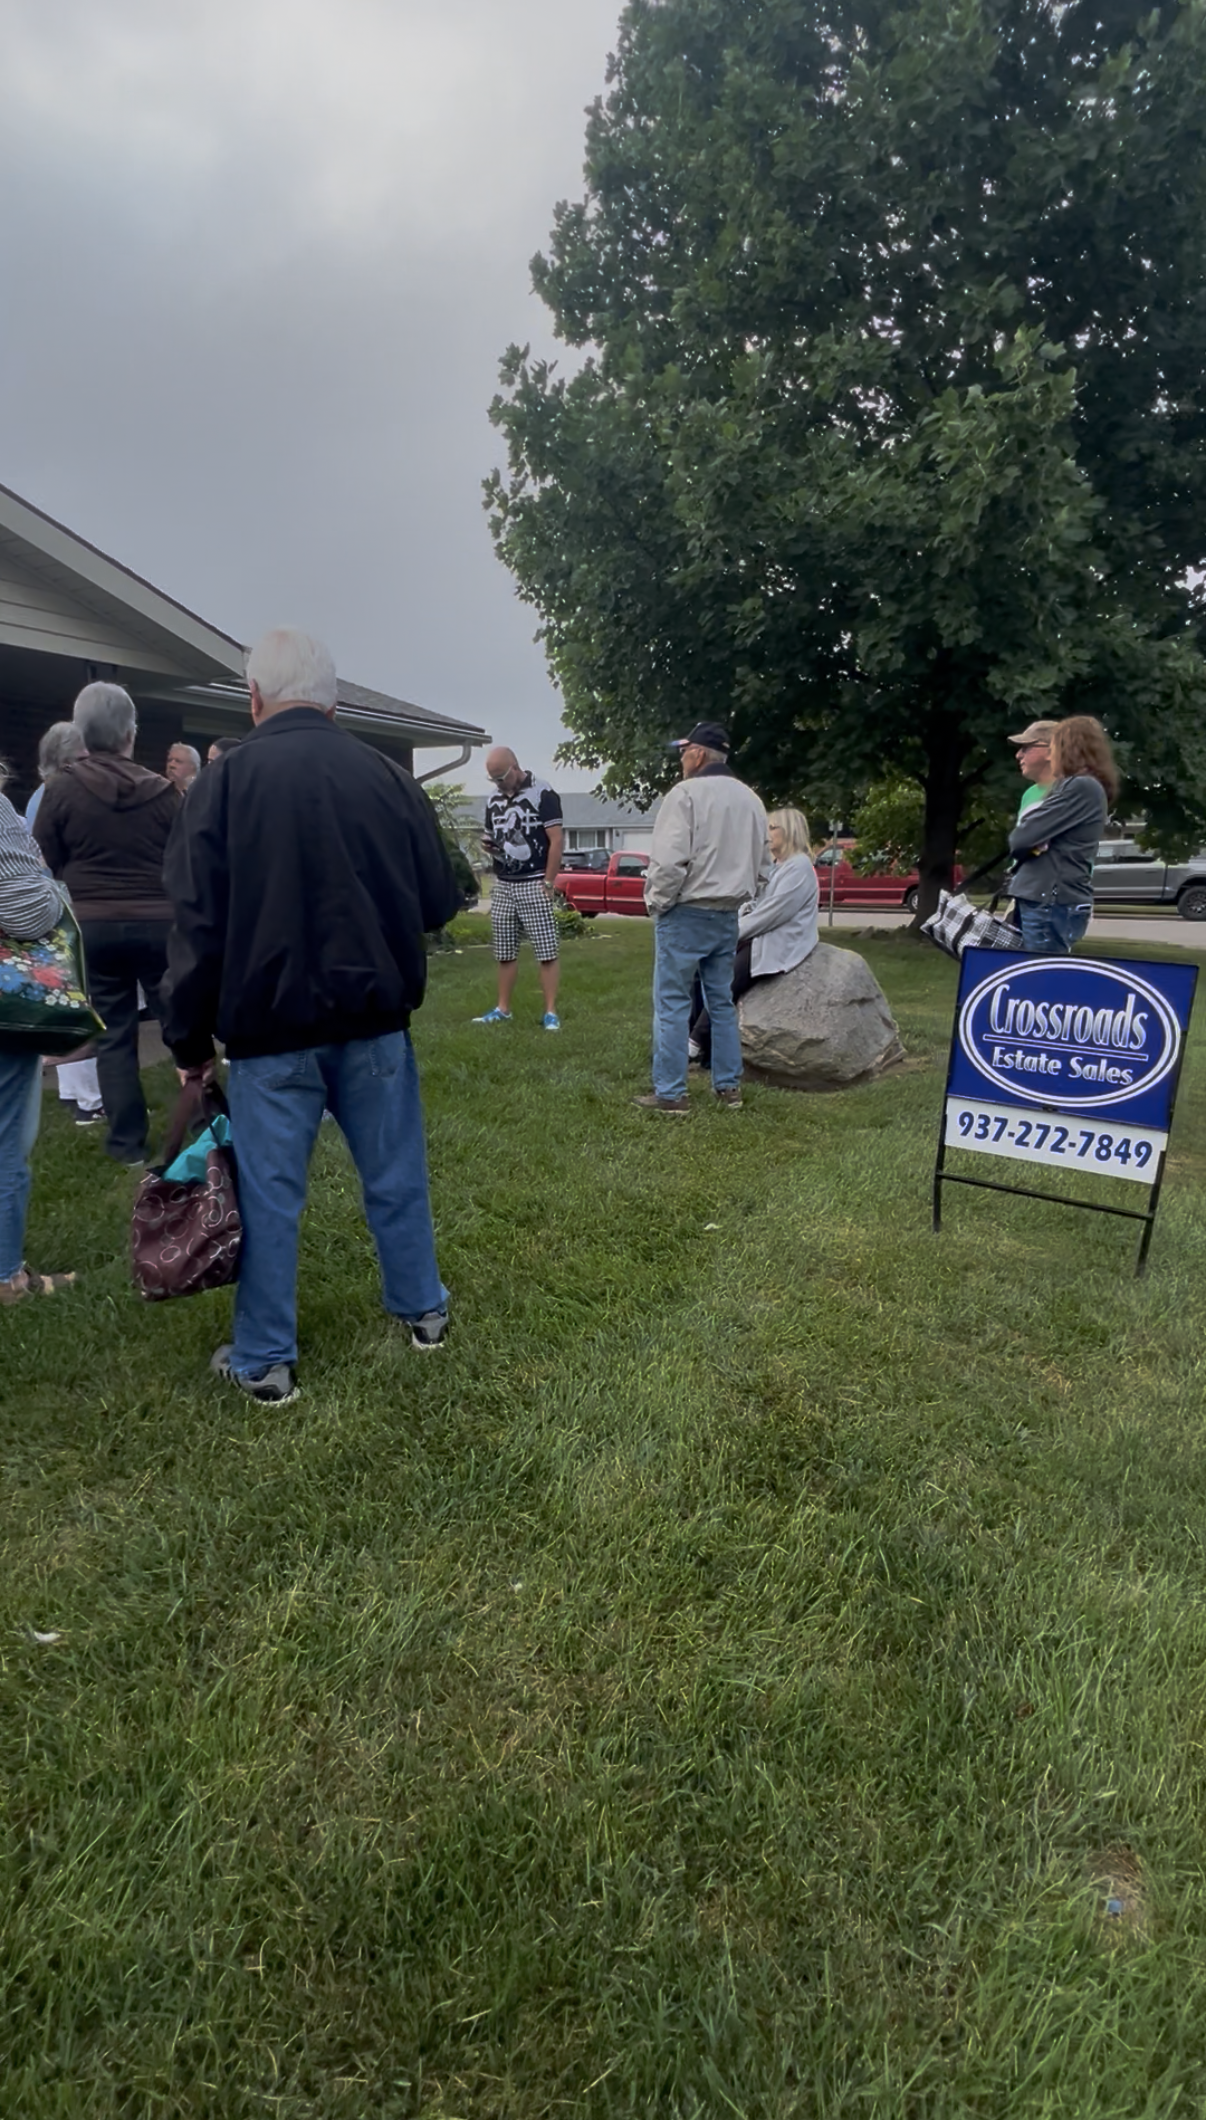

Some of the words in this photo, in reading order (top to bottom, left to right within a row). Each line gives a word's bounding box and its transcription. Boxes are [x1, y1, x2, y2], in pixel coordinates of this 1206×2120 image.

[990, 984, 1148, 1049] Crossroads
[992, 1046, 1062, 1075] Estate
[1068, 1056, 1133, 1085] Sales
[958, 1111, 1153, 1168] 937-272-7849
